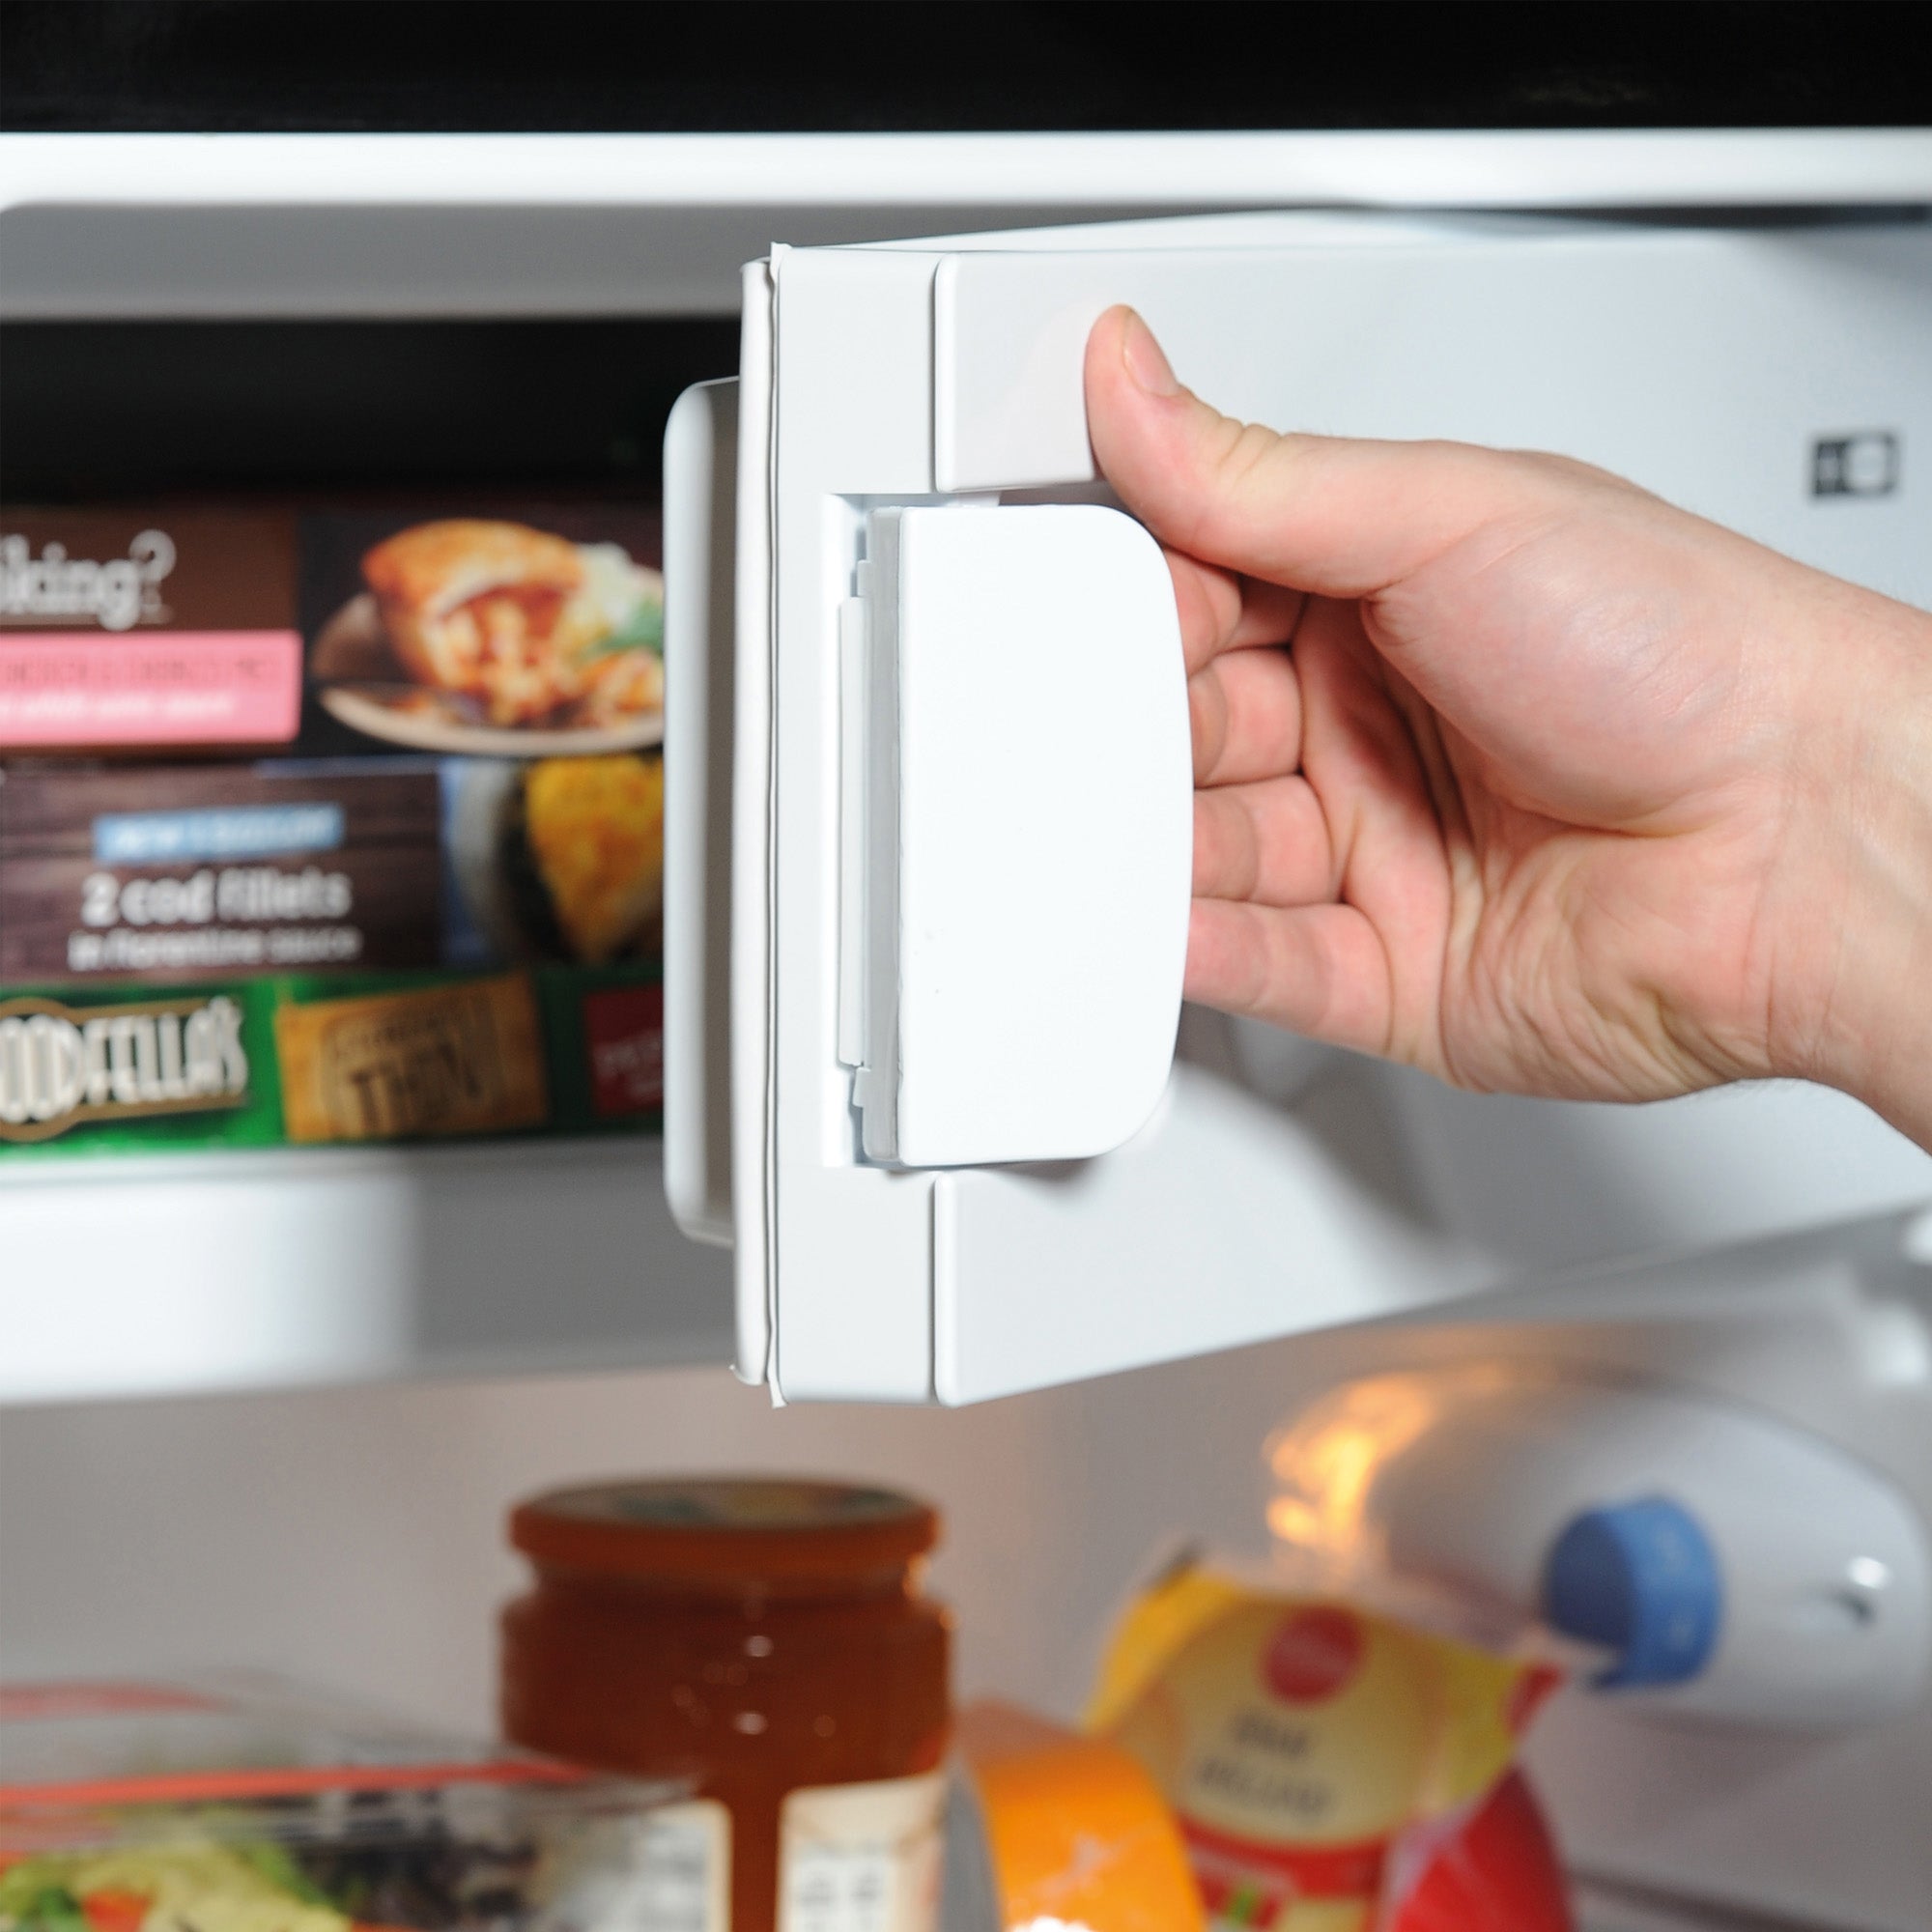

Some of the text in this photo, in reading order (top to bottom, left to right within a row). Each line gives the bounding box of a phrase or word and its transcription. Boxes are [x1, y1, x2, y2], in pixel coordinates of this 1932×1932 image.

[0, 528, 177, 632] king?
[82, 867, 352, 926] 2 cod fillets
[68, 929, 103, 971] in
[266, 924, 364, 964] sauce
